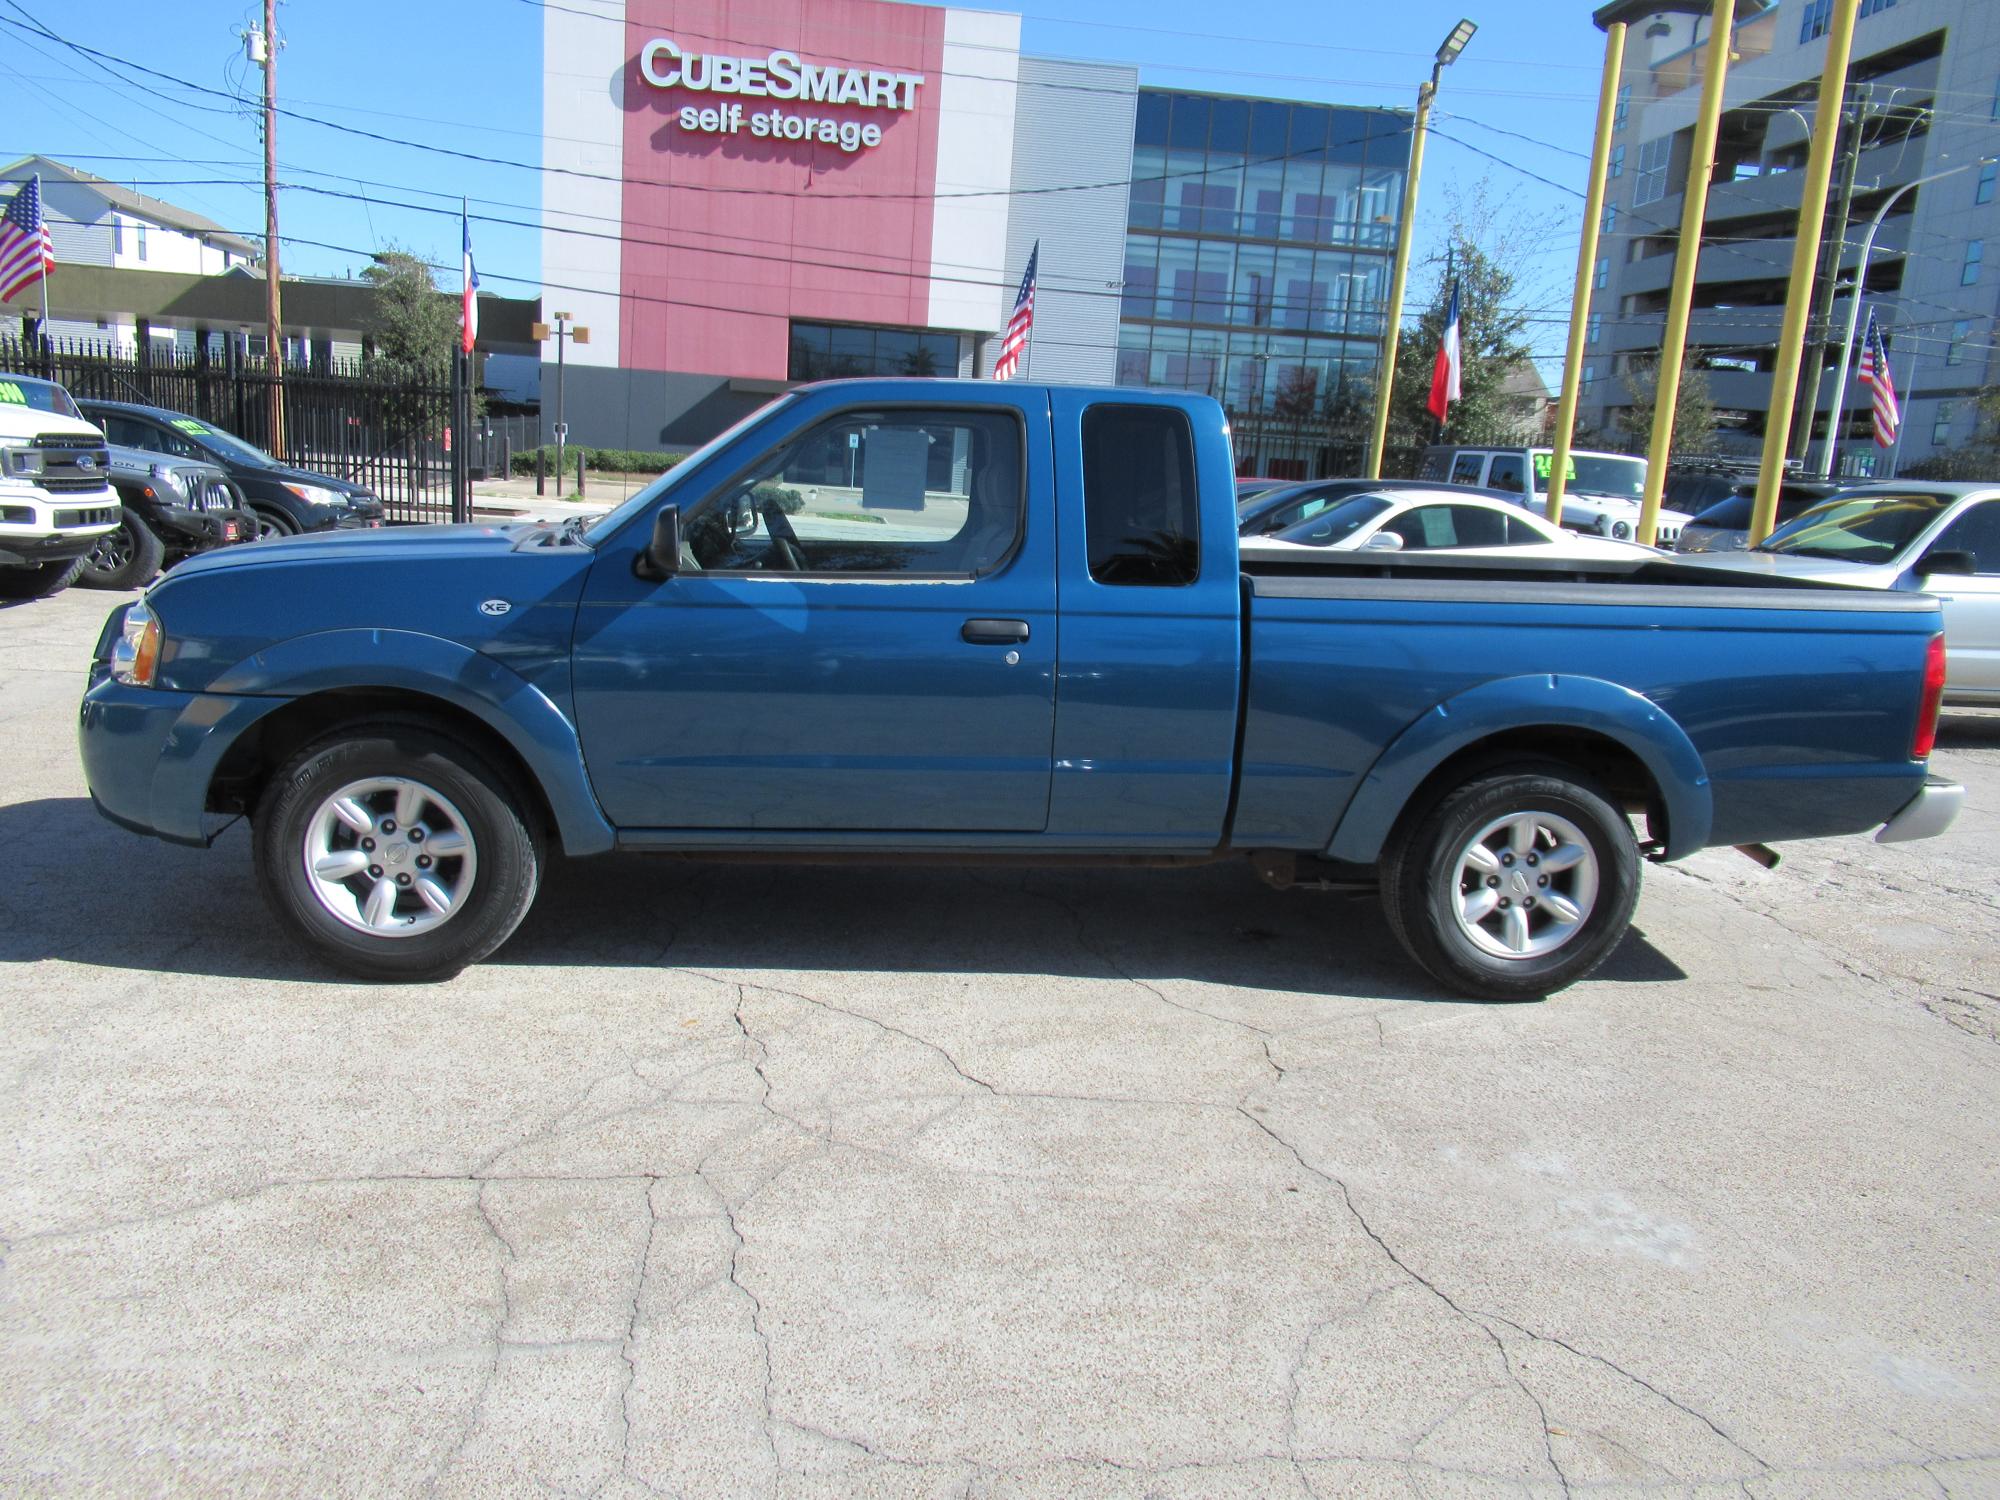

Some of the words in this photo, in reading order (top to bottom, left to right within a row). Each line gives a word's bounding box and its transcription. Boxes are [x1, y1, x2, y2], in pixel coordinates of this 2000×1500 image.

[641, 38, 925, 110] CUBESMART
[679, 102, 742, 134] self
[751, 109, 882, 152] storage
[484, 603, 508, 612] XE
